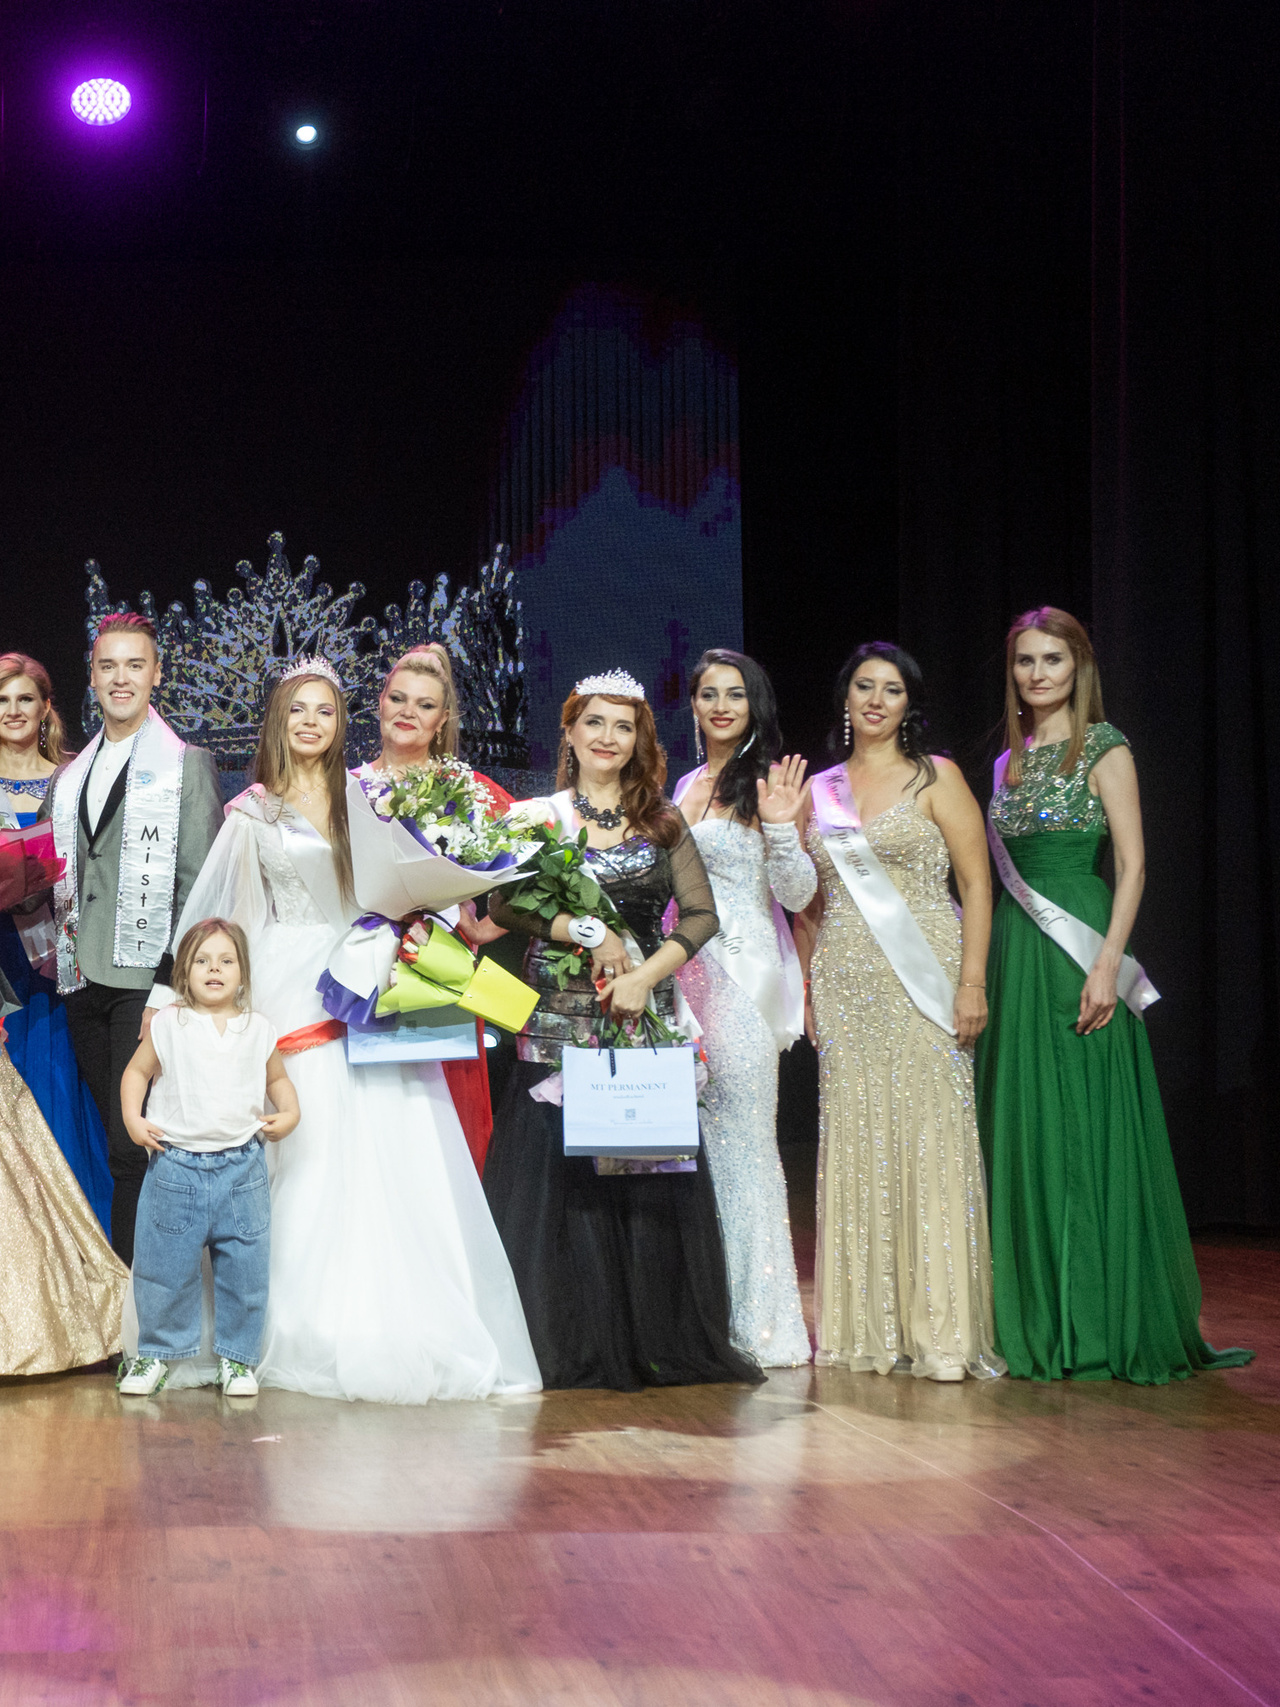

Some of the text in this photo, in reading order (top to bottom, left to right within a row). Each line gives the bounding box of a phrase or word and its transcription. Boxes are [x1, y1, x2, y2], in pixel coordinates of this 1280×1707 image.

[136, 825, 160, 952] Mister
[1010, 879, 1068, 930] Model
[591, 1082, 667, 1091] MT PERMANENT
